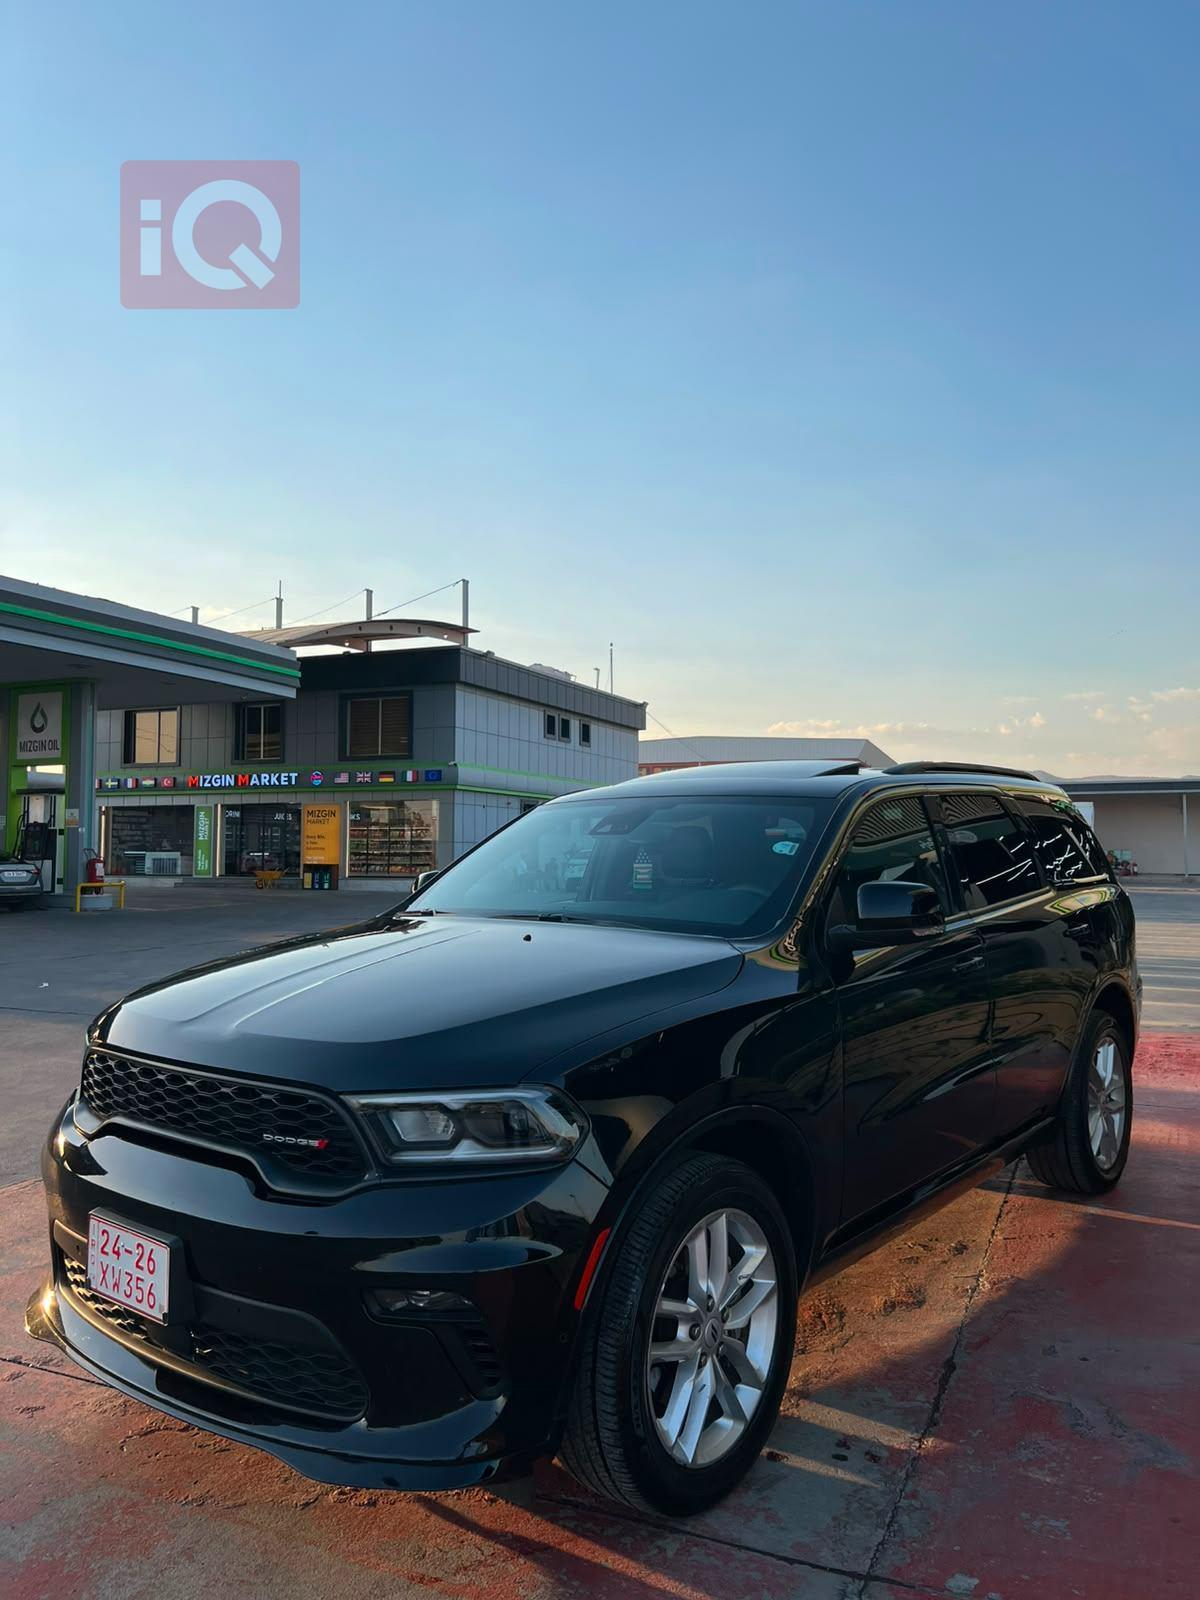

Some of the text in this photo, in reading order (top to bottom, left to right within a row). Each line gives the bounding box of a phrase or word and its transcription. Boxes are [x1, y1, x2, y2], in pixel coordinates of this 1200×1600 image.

[20, 739, 60, 753] MIZGIN OIL
[188, 772, 298, 787] MIZGIN MARKET
[306, 809, 336, 818] MIZGIN
[263, 1133, 319, 1147] DODGE
[100, 1229, 156, 1275] 24-26
